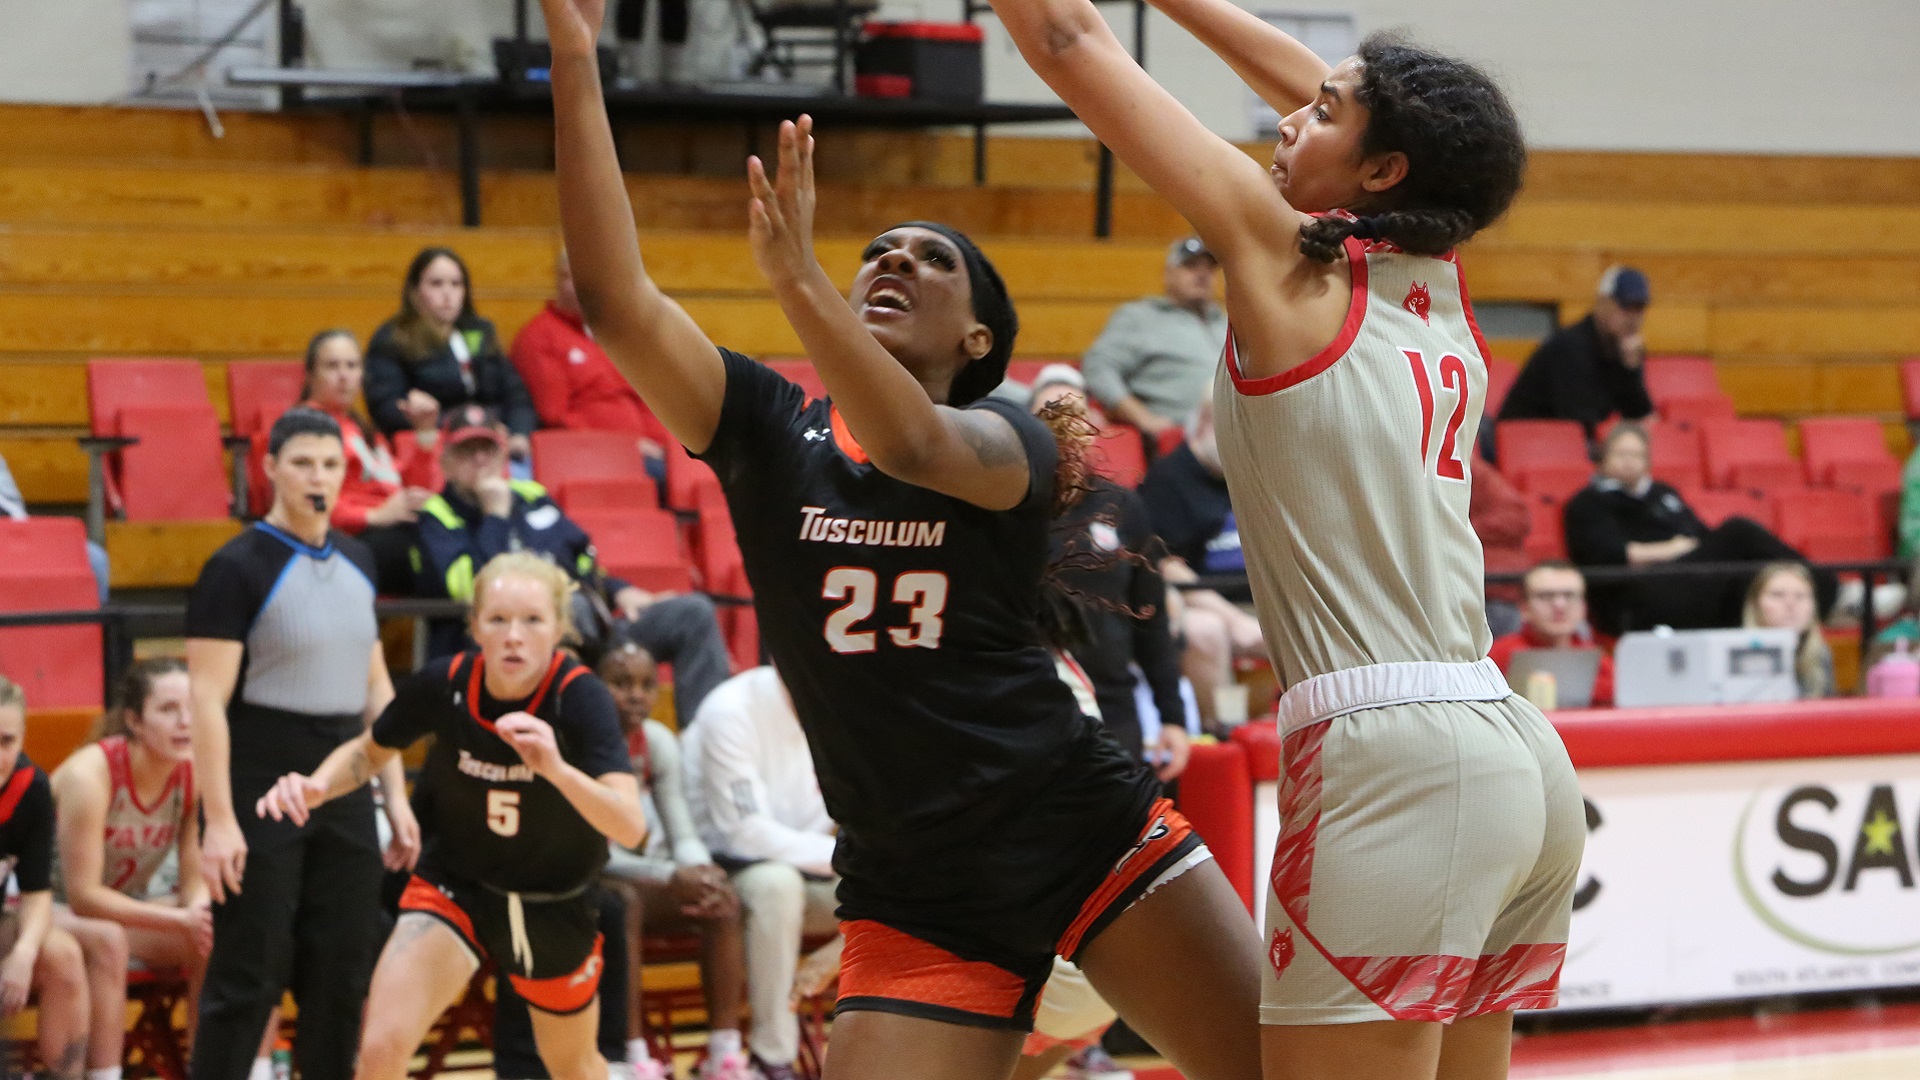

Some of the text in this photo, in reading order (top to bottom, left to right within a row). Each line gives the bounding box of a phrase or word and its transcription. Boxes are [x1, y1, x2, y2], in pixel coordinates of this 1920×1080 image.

[1396, 346, 1467, 484] 12
[800, 505, 946, 547] TUSCULUM
[822, 566, 949, 655] 23
[487, 788, 520, 837] 5
[1770, 783, 1920, 898] SA
